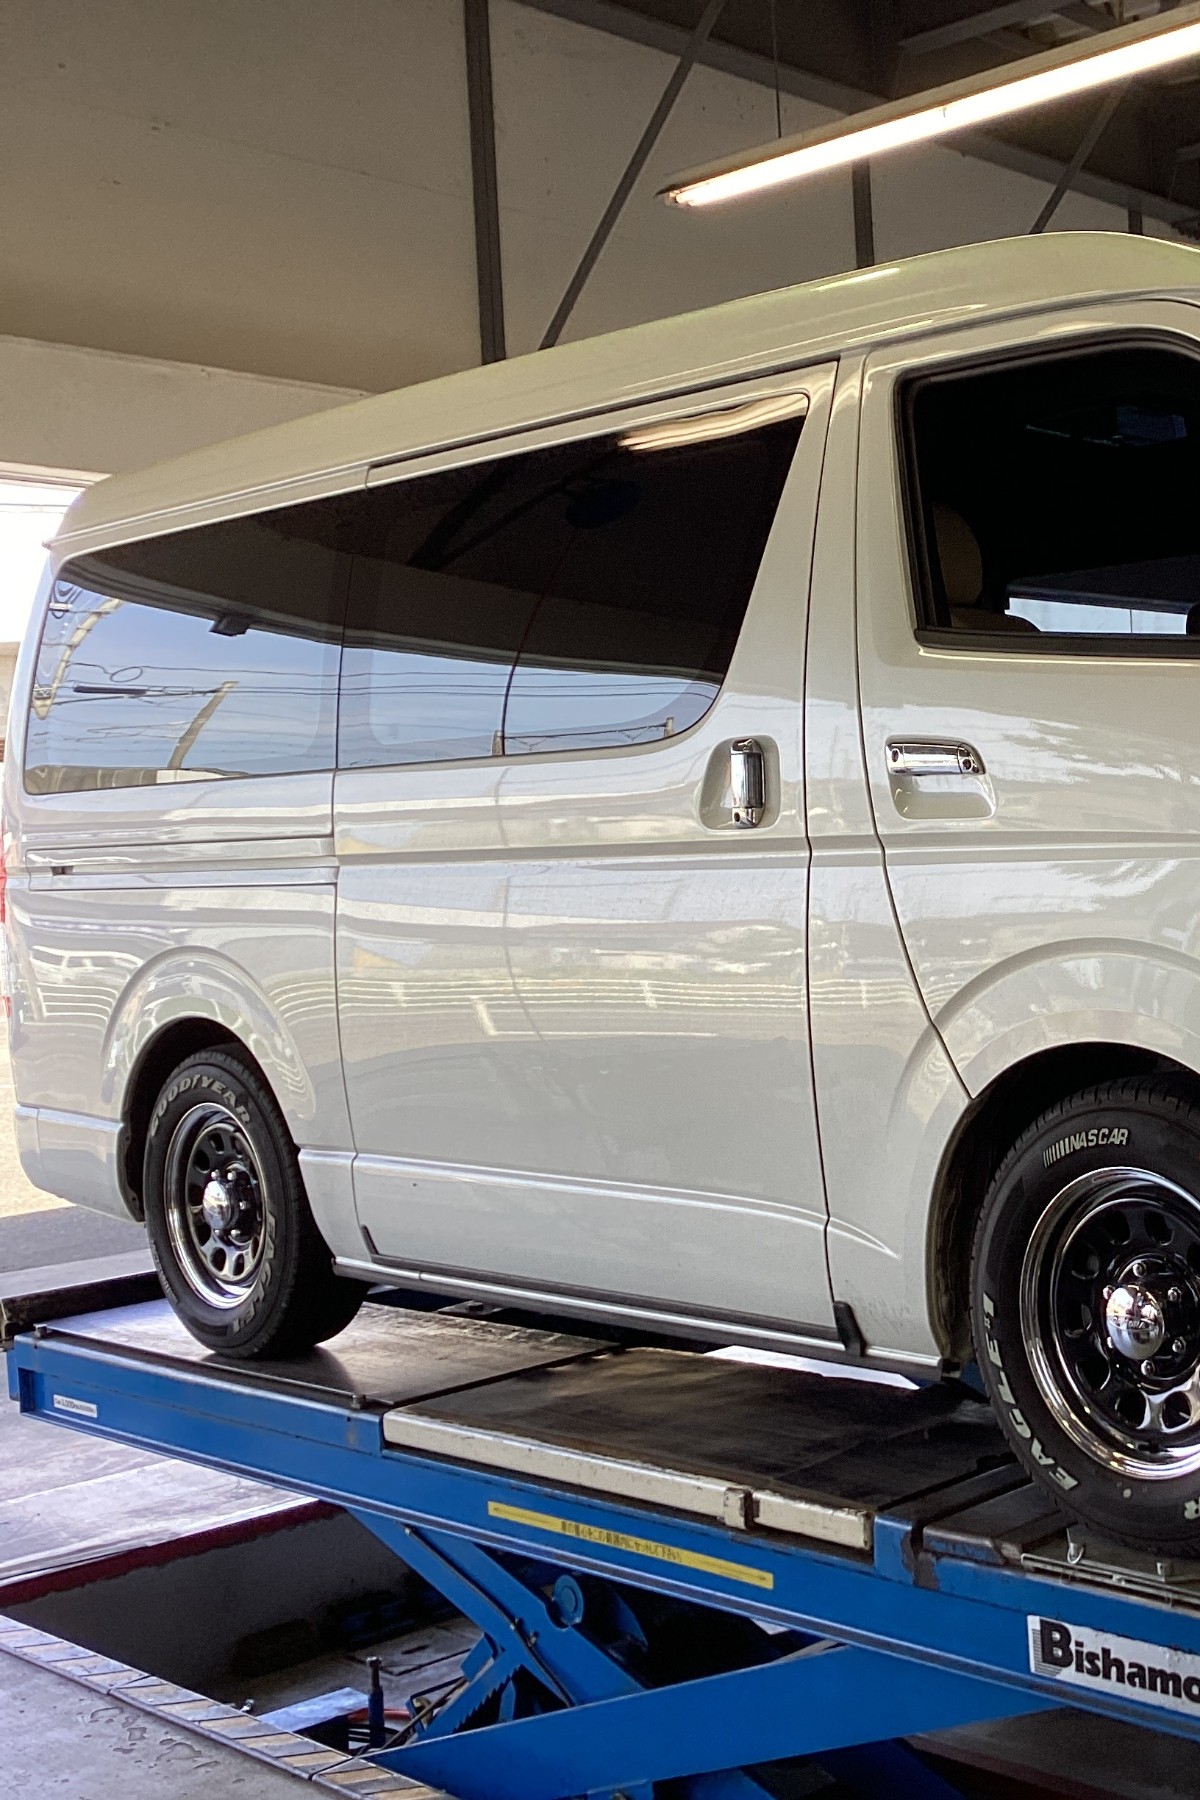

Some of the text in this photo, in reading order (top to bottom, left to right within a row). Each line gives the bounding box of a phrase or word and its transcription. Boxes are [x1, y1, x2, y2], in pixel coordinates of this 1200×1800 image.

[150, 1074, 251, 1137] GOODYEAR
[1070, 1127, 1129, 1153] NASCAR
[985, 1332, 1079, 1491] EAGLE
